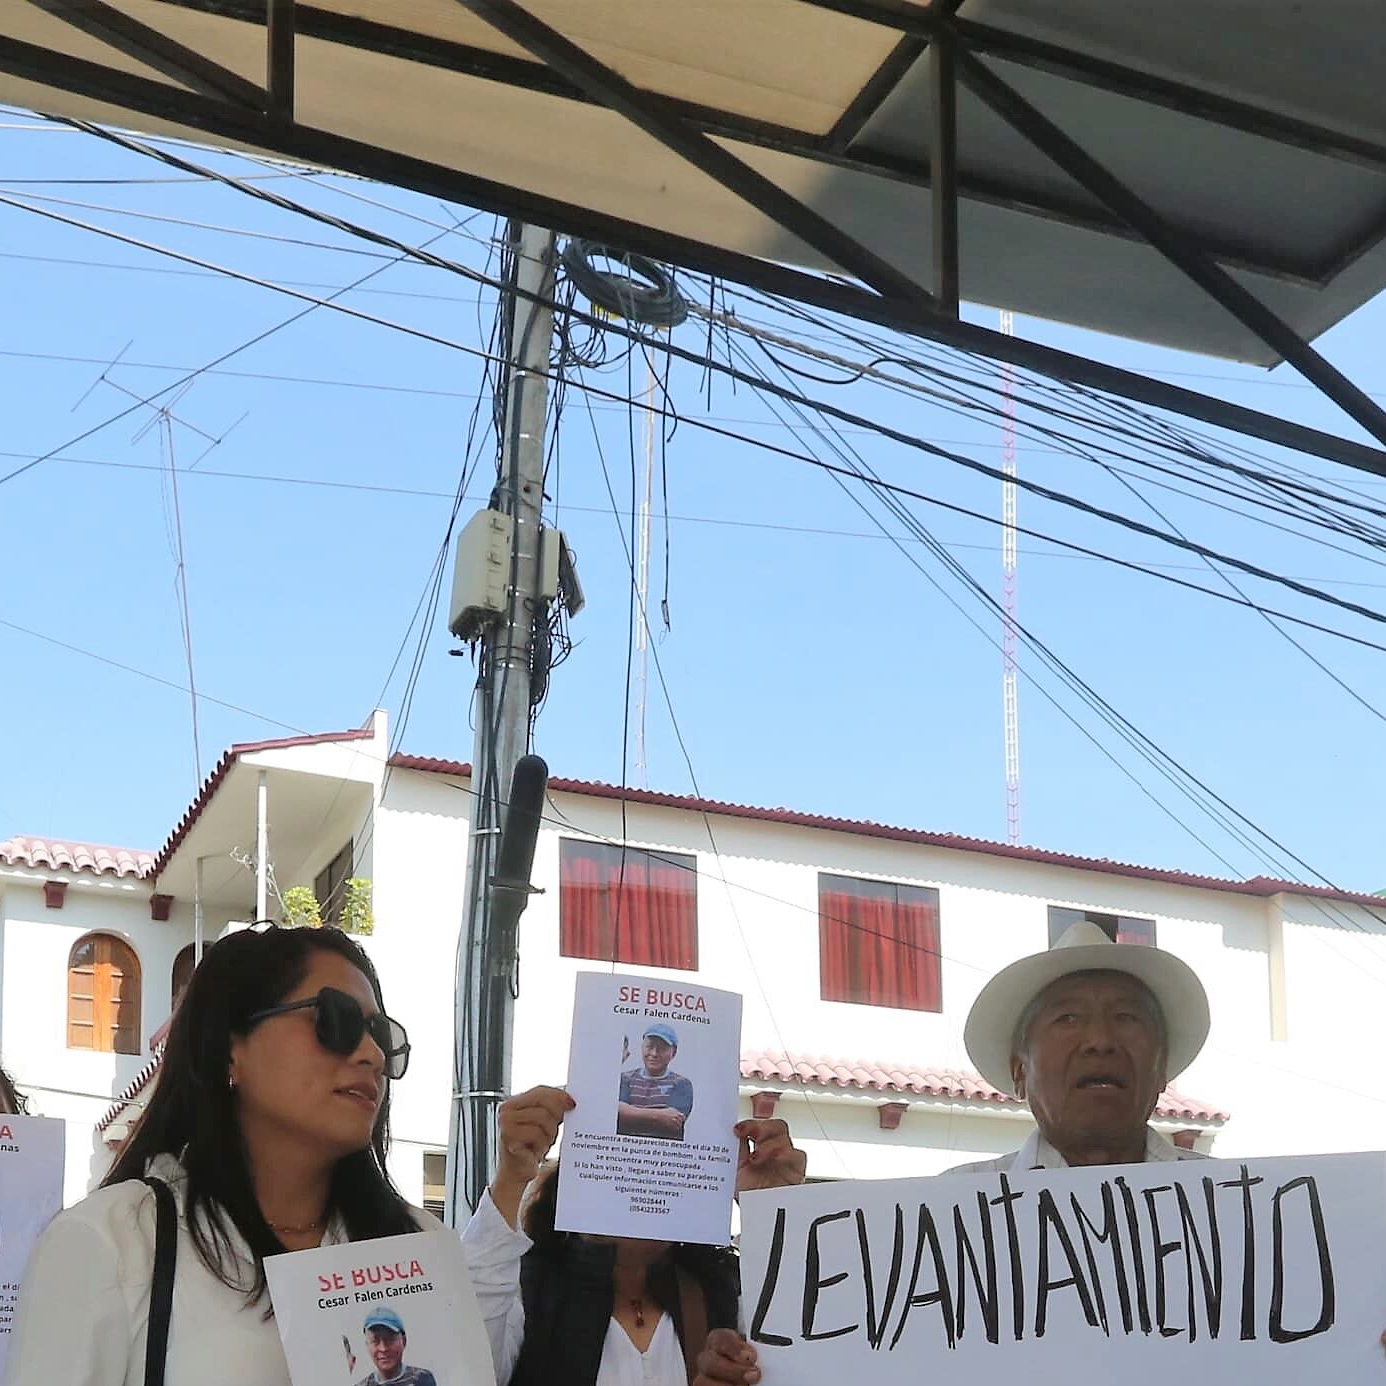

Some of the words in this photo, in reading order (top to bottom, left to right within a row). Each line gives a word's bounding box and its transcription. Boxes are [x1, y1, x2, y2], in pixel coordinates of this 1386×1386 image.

[618, 986, 641, 1003] SE
[646, 989, 707, 1013] BUSCA
[613, 1004, 640, 1015] Cesar
[644, 1008, 669, 1018] Falen
[671, 1011, 711, 1024] Cardenas
[749, 1165, 1336, 1350] LEVANTAMIENTO
[318, 1273, 346, 1292] SE
[351, 1260, 424, 1287] BUSCA
[318, 1296, 349, 1309] Cesar
[354, 1290, 384, 1303] Falen
[385, 1282, 433, 1298] Cardenas
